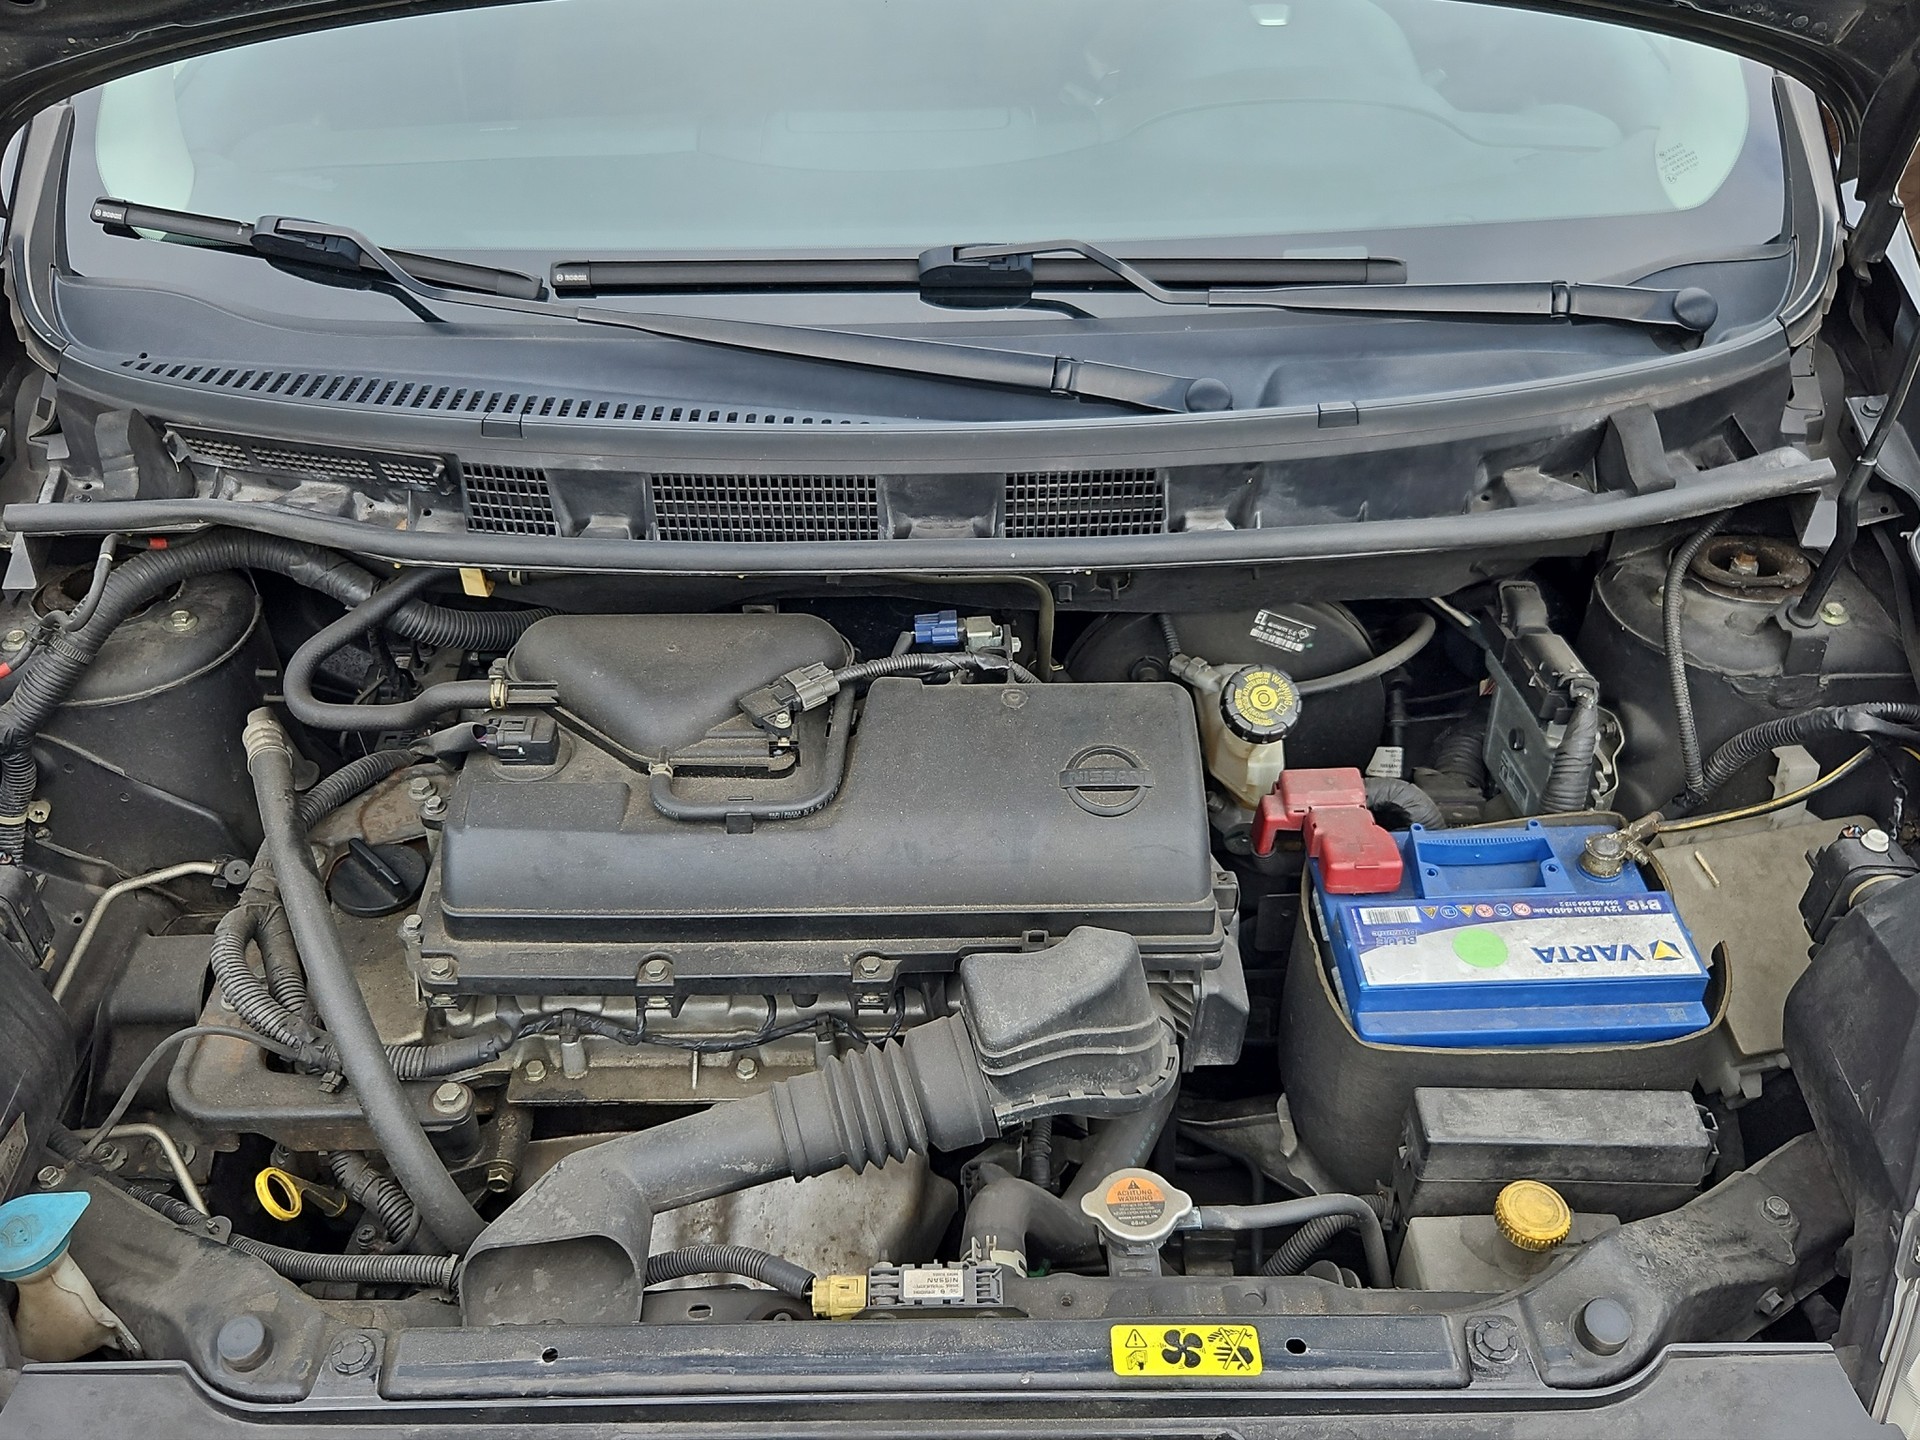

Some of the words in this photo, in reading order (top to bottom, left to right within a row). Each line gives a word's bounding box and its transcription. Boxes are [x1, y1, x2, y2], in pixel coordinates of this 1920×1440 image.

[1271, 674, 1293, 706] WARNING
[1068, 770, 1146, 783] NISSAN
[1626, 899, 1662, 911] B18
[1376, 936, 1417, 946] BLUE
[1530, 944, 1645, 963] VARTA
